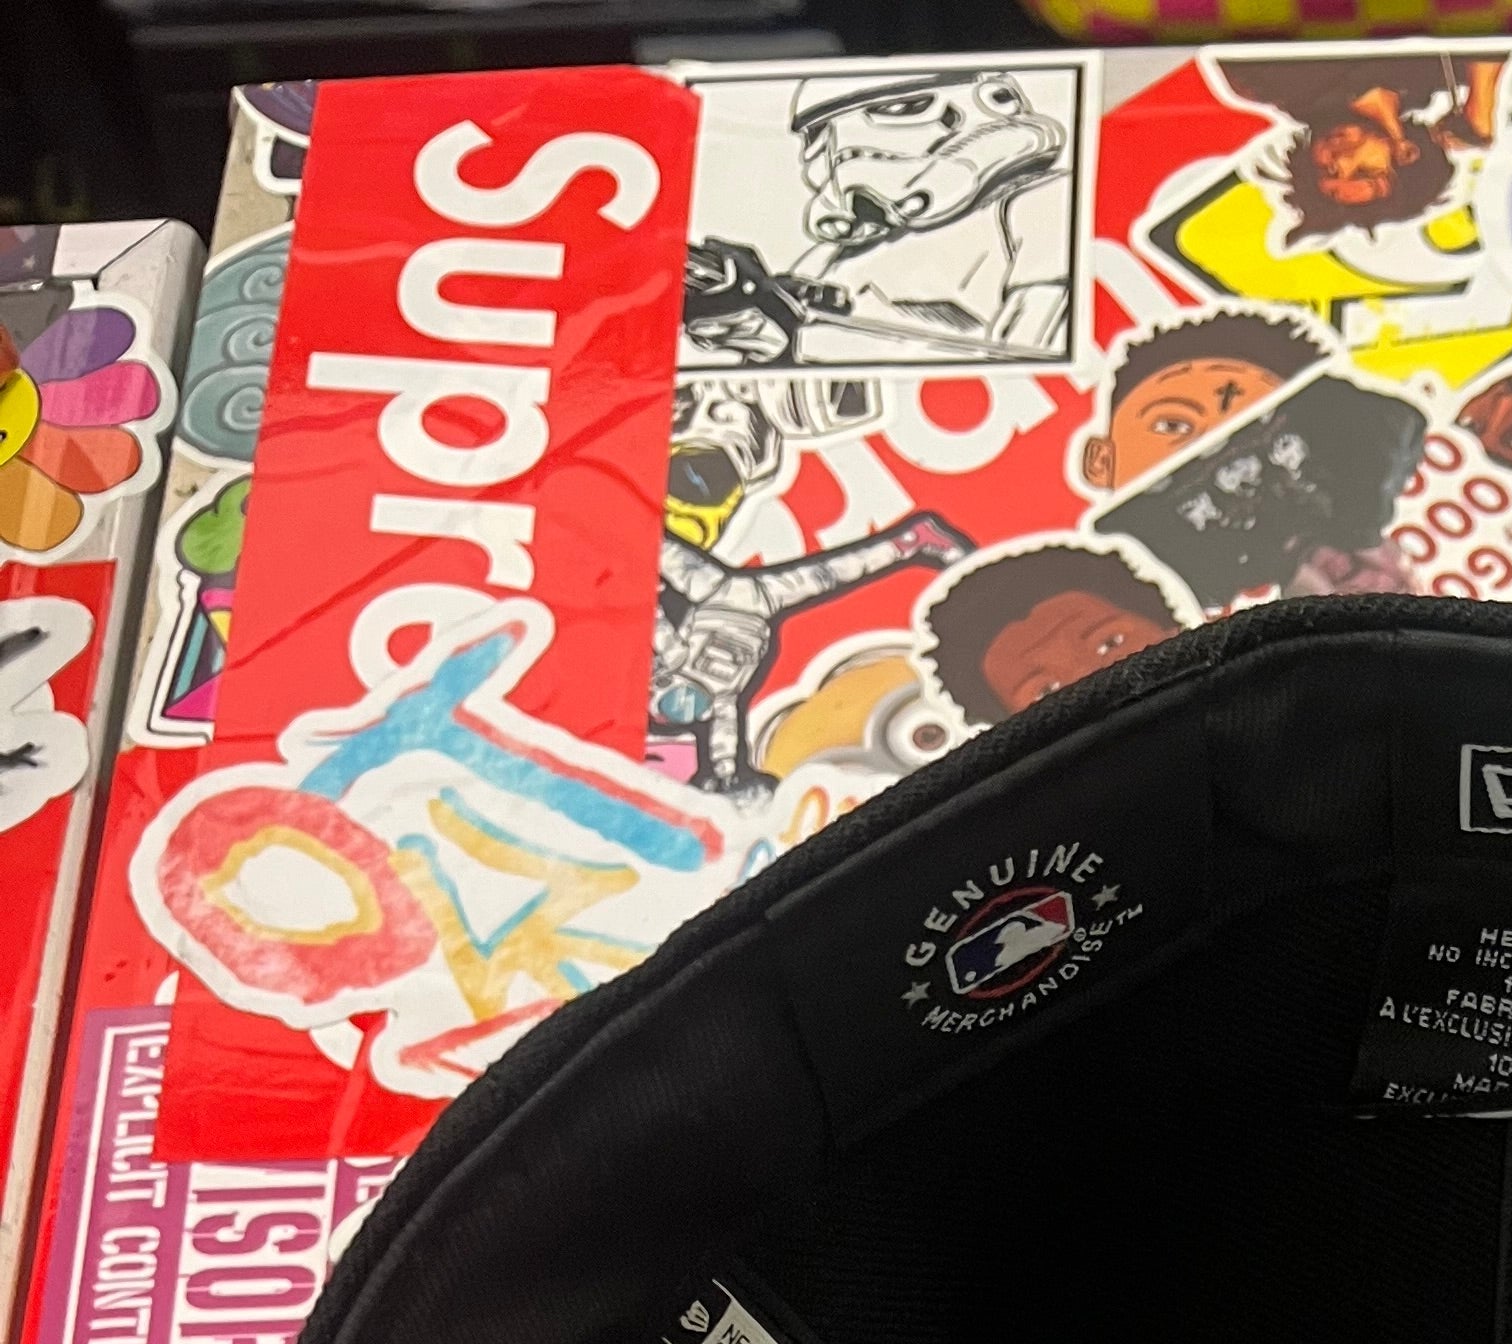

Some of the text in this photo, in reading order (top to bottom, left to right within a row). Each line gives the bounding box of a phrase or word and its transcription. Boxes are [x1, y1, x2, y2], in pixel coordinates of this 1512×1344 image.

[306, 118, 661, 690] Supr
[905, 842, 1104, 967] GENUINE
[1428, 944, 1461, 963] NO
